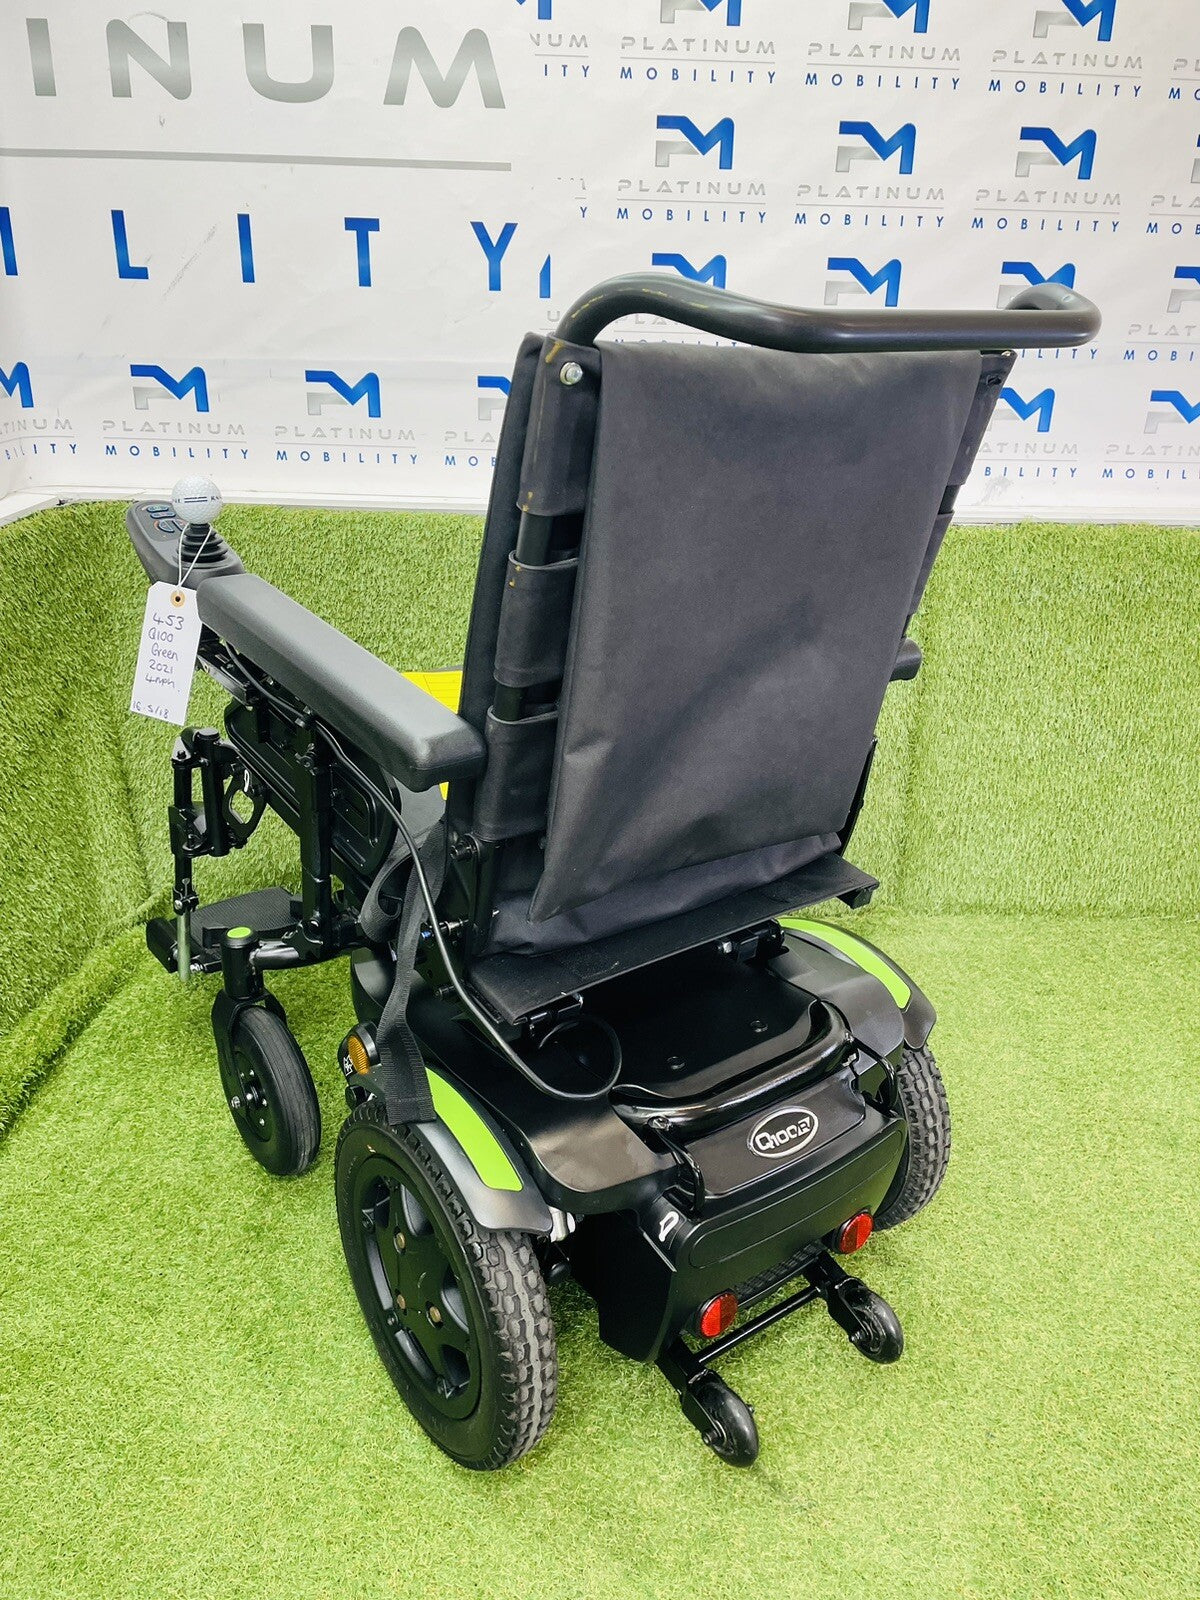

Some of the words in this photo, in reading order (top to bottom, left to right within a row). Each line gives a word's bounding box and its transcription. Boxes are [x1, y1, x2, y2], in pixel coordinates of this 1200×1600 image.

[622, 36, 775, 54] PLATINUM
[808, 43, 960, 61] PLATINUM
[993, 50, 1142, 69] PLATINUM
[620, 67, 775, 83] MOBILITY
[806, 73, 959, 89] MOBILITY
[989, 80, 1141, 97] MOBILITY
[618, 179, 766, 195] PLATINUM
[797, 184, 944, 200] PLATINUM
[976, 189, 1120, 205] PLATINUM
[617, 208, 765, 223] MOBILITY
[795, 213, 943, 227] MOBILITY
[972, 218, 1119, 232] MOBILITY
[0, 419, 72, 434] TINUM
[103, 420, 245, 435] PLATINUM
[275, 426, 415, 440] PLATINUM
[106, 445, 247, 459] MOBILITY
[277, 451, 417, 464] MOBILITY
[152, 613, 184, 630] 453
[151, 642, 178, 660] Green
[149, 659, 173, 673] 2021
